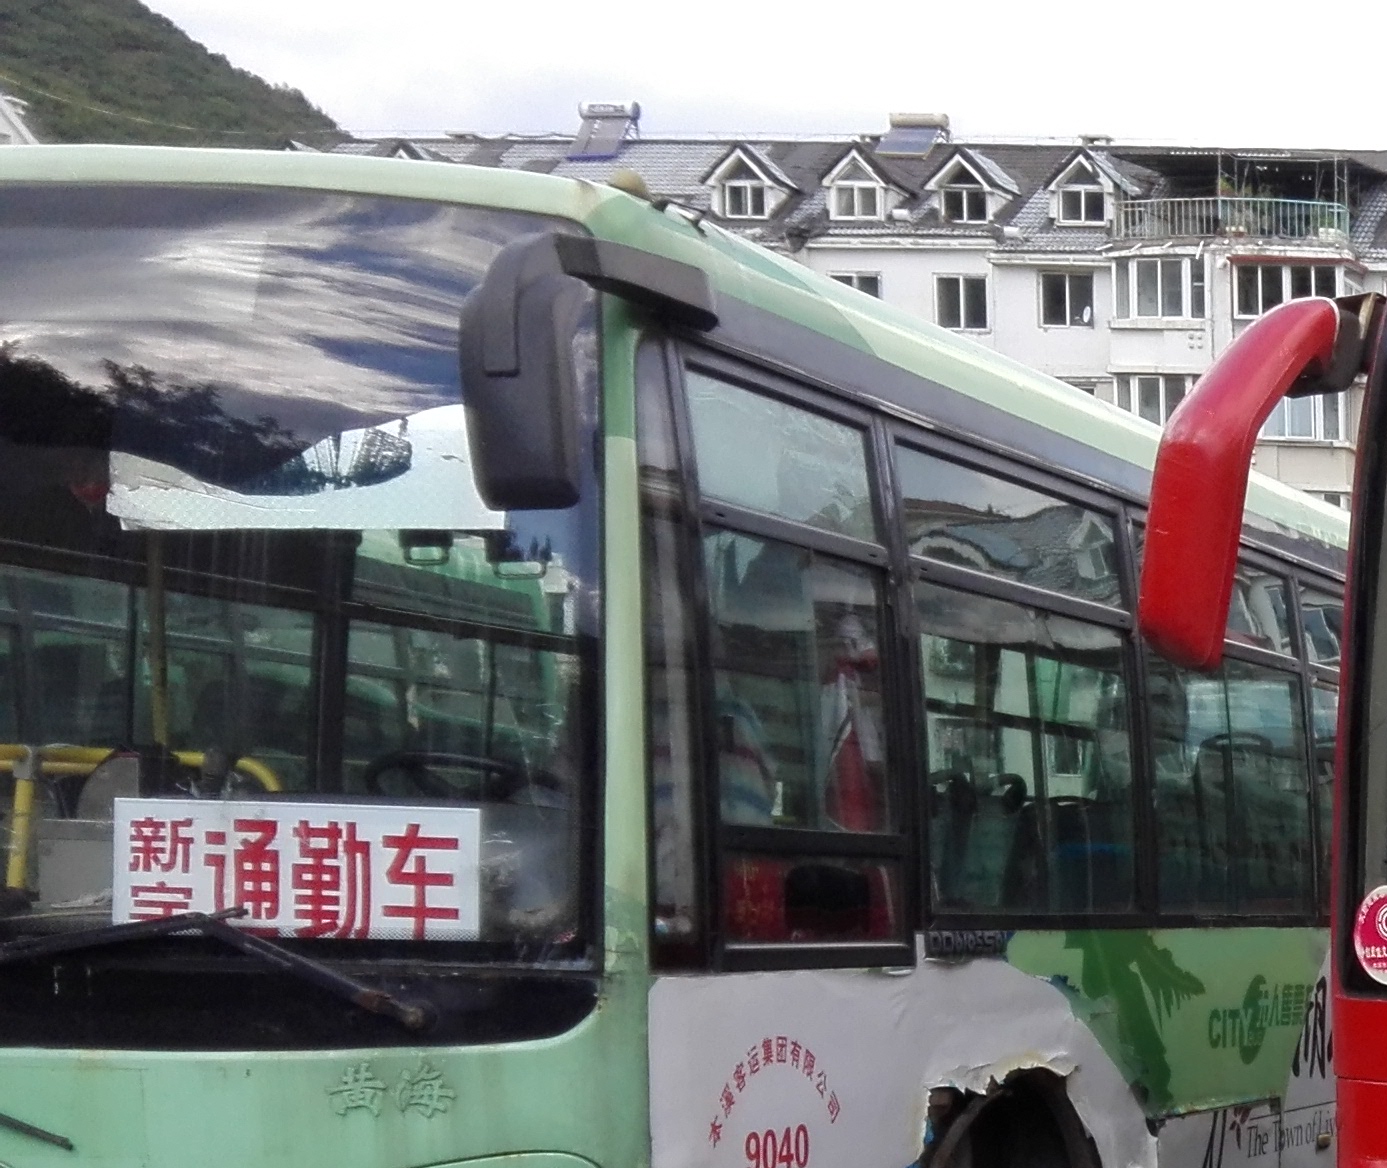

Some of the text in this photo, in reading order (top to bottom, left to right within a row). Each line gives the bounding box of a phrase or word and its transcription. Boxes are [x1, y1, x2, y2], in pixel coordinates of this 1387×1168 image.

[204, 818, 459, 940] 通勤车
[1246, 1125, 1269, 1158] The
